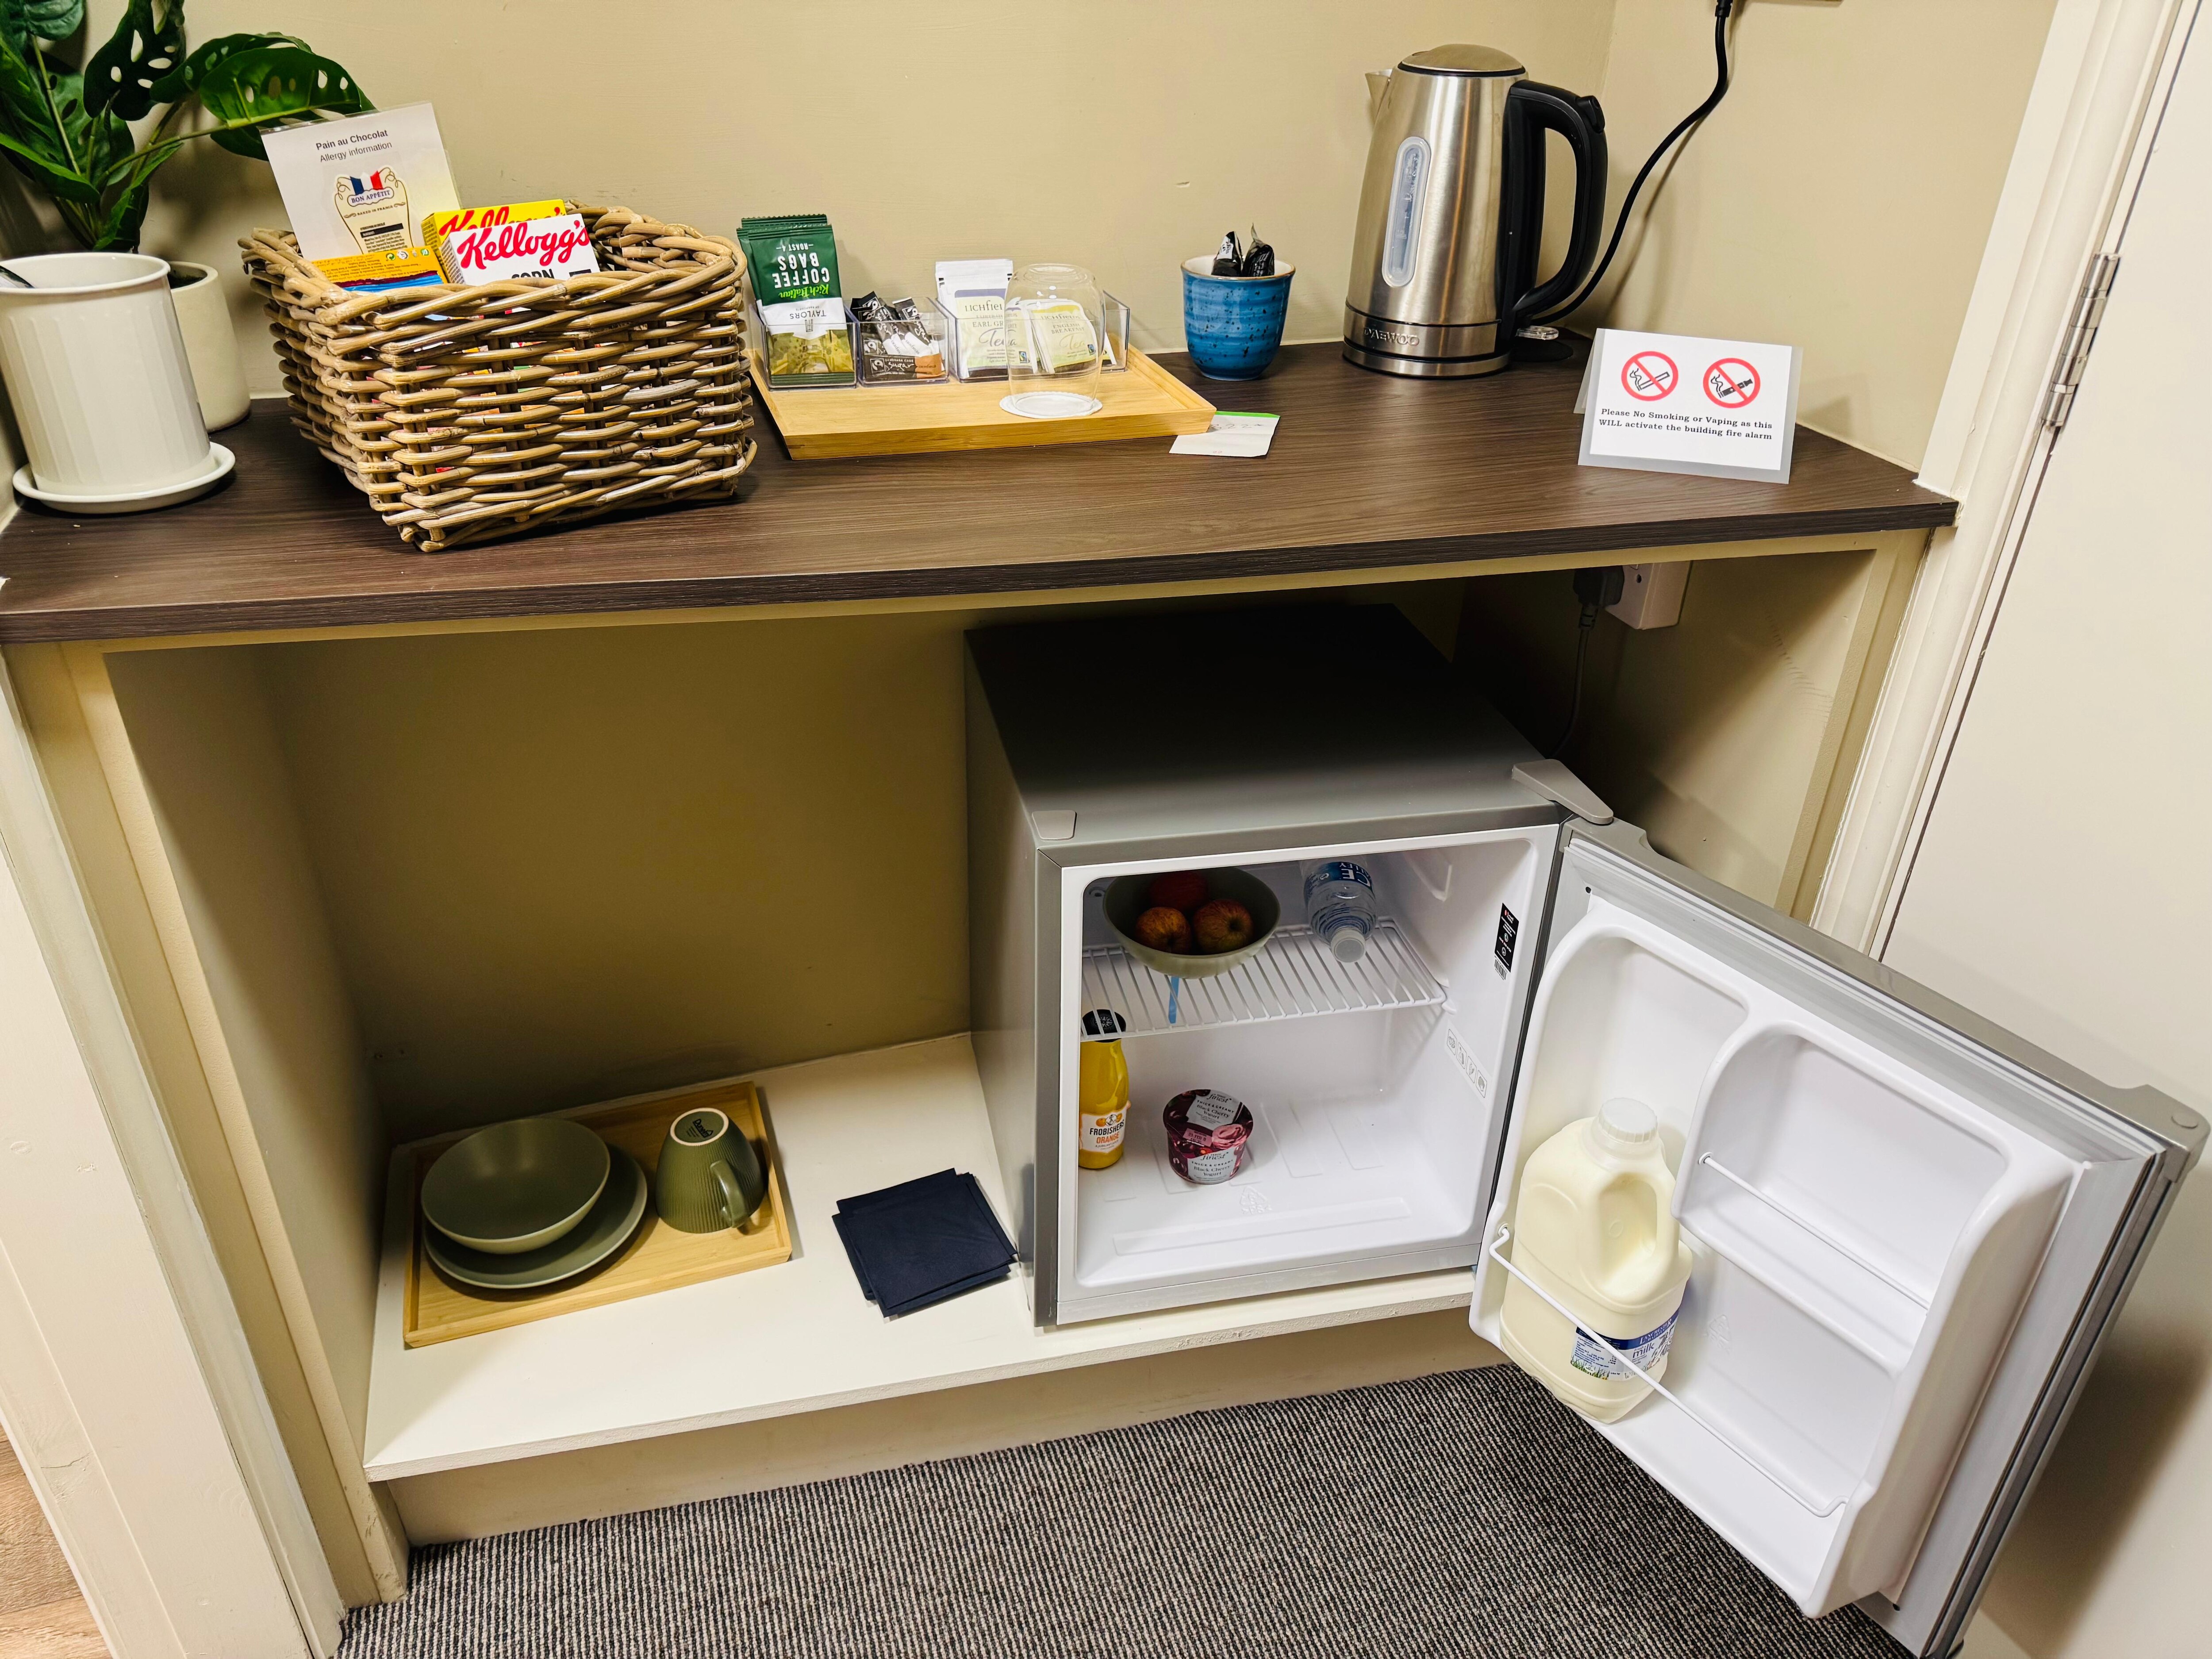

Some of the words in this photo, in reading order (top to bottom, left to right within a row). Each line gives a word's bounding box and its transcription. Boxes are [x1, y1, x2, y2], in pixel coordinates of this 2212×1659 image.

[316, 141, 336, 150] Pain
[350, 130, 388, 143] Chocolat
[320, 151, 347, 162] Allergy
[349, 142, 392, 156] information
[457, 219, 590, 269] Kellogg's
[777, 252, 819, 271] BAGS
[772, 267, 830, 288] COFFEE
[778, 286, 810, 299] Italian
[809, 284, 830, 296] Rich
[790, 310, 826, 319] TAYLORS
[1363, 327, 1420, 346] DAEWOO
[1601, 408, 1630, 417] Please
[1648, 411, 1690, 422] Smoking
[1705, 416, 1738, 427] Vaping
[1625, 421, 1663, 430] activate
[1685, 426, 1723, 437] building
[1745, 431, 1772, 440] alarm
[1096, 1131, 1119, 1144] ORANGE
[1632, 1342, 1655, 1358] milk
